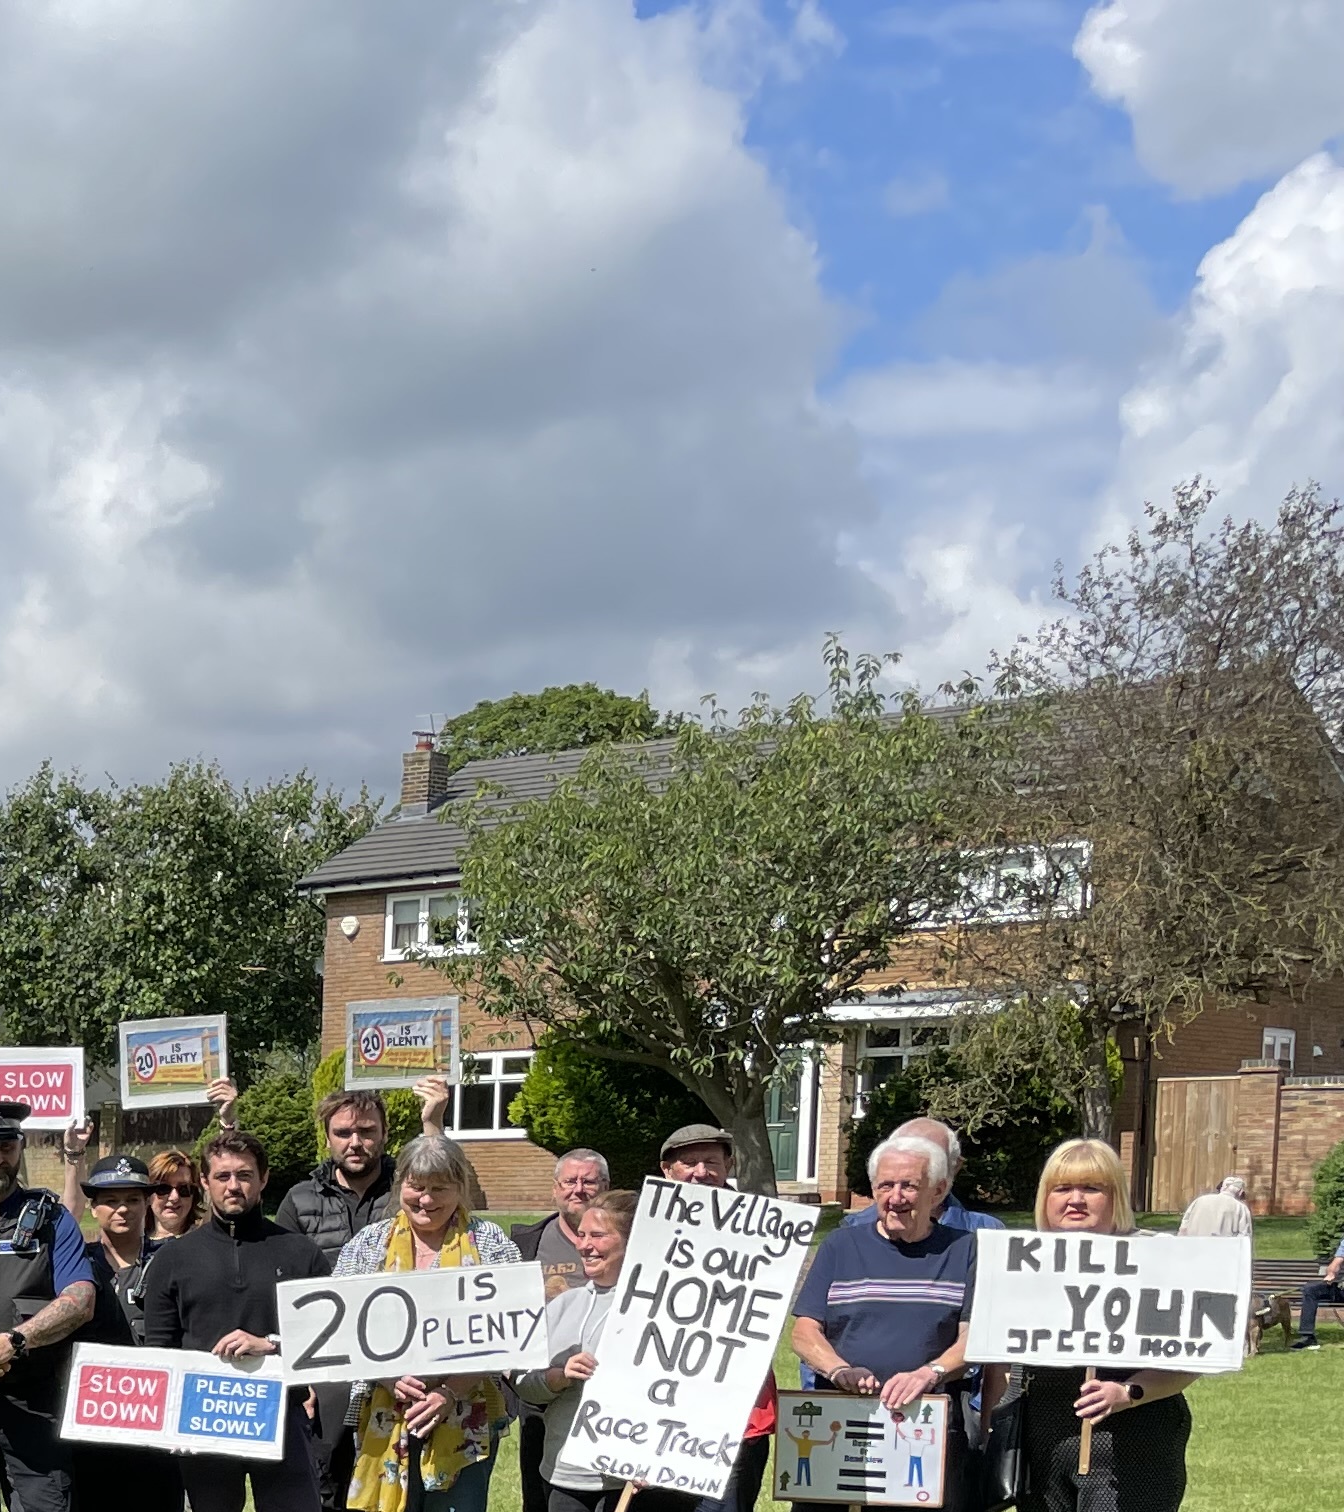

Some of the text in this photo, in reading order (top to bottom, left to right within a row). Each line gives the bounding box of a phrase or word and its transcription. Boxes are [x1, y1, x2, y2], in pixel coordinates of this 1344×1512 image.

[387, 1035, 428, 1047] PLENTY
[401, 1026, 410, 1035] IS
[172, 1043, 181, 1053] IS
[363, 1034, 380, 1054] 20
[136, 1053, 153, 1072] 20
[159, 1052, 197, 1064] PLENTY
[4, 1071, 64, 1088] SLOW
[646, 1179, 813, 1257] The Village
[666, 1229, 772, 1281] is our
[1007, 1236, 1138, 1275] KILL
[458, 1273, 496, 1300] IS
[619, 1263, 783, 1341] HOME
[291, 1286, 419, 1370] 20
[422, 1306, 545, 1352] PLENTY
[634, 1320, 746, 1383] NOT
[90, 1374, 157, 1396] SLOW
[197, 1379, 268, 1399] PLEASE
[647, 1379, 680, 1407] a
[82, 1400, 158, 1423] DOWN
[202, 1398, 257, 1417] DRIVE
[190, 1417, 266, 1437] SLOWLY
[571, 1400, 741, 1467] Race Track
[590, 1455, 722, 1493] SLOW DOWN
